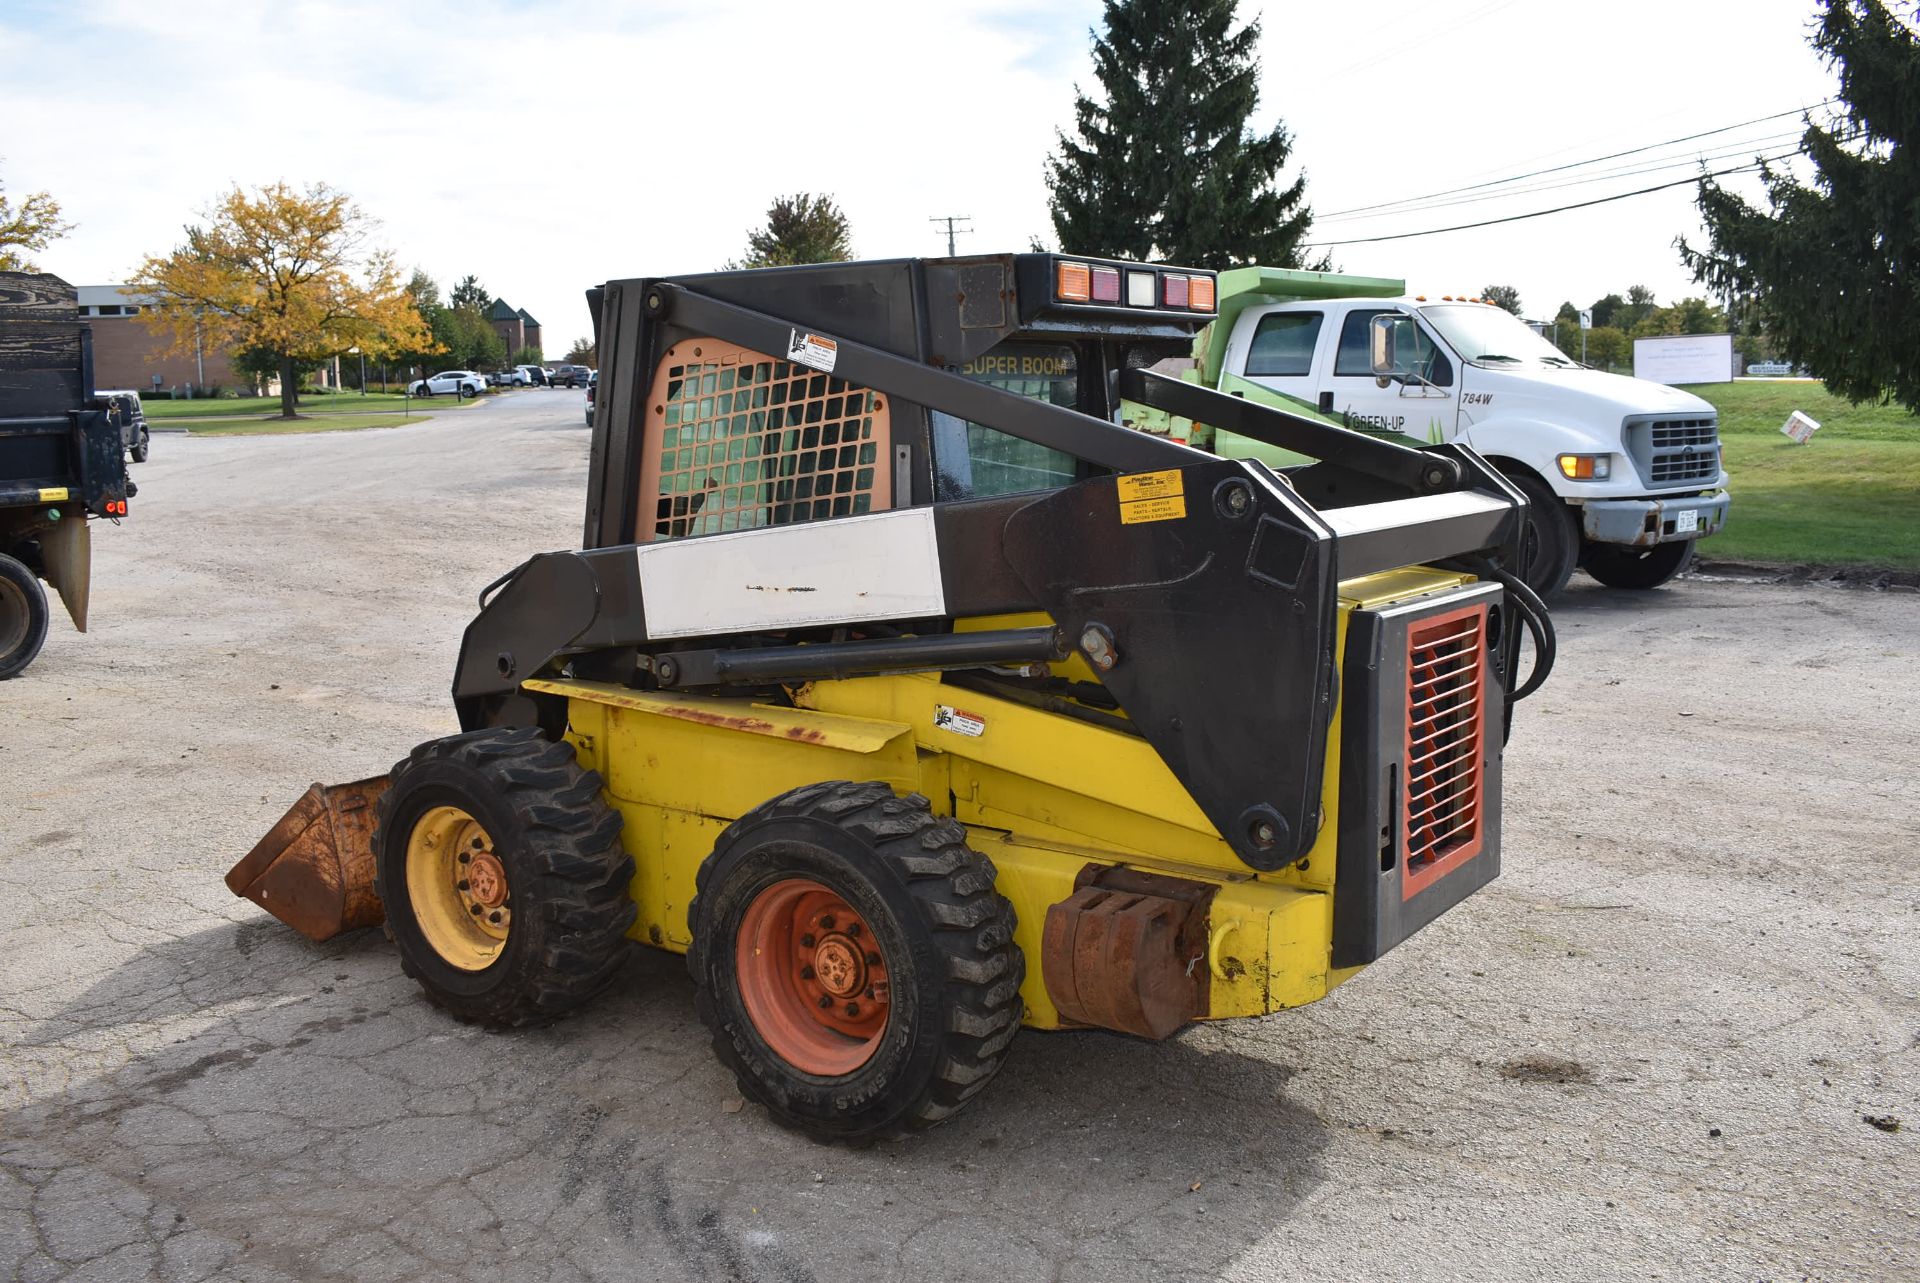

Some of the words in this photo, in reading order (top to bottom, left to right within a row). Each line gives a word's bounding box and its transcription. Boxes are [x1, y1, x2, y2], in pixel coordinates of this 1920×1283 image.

[963, 356, 1018, 375] SUPER
[1022, 356, 1067, 375] BOOM
[1462, 393, 1493, 405] 784W
[1352, 414, 1405, 430] GREEN-UP
